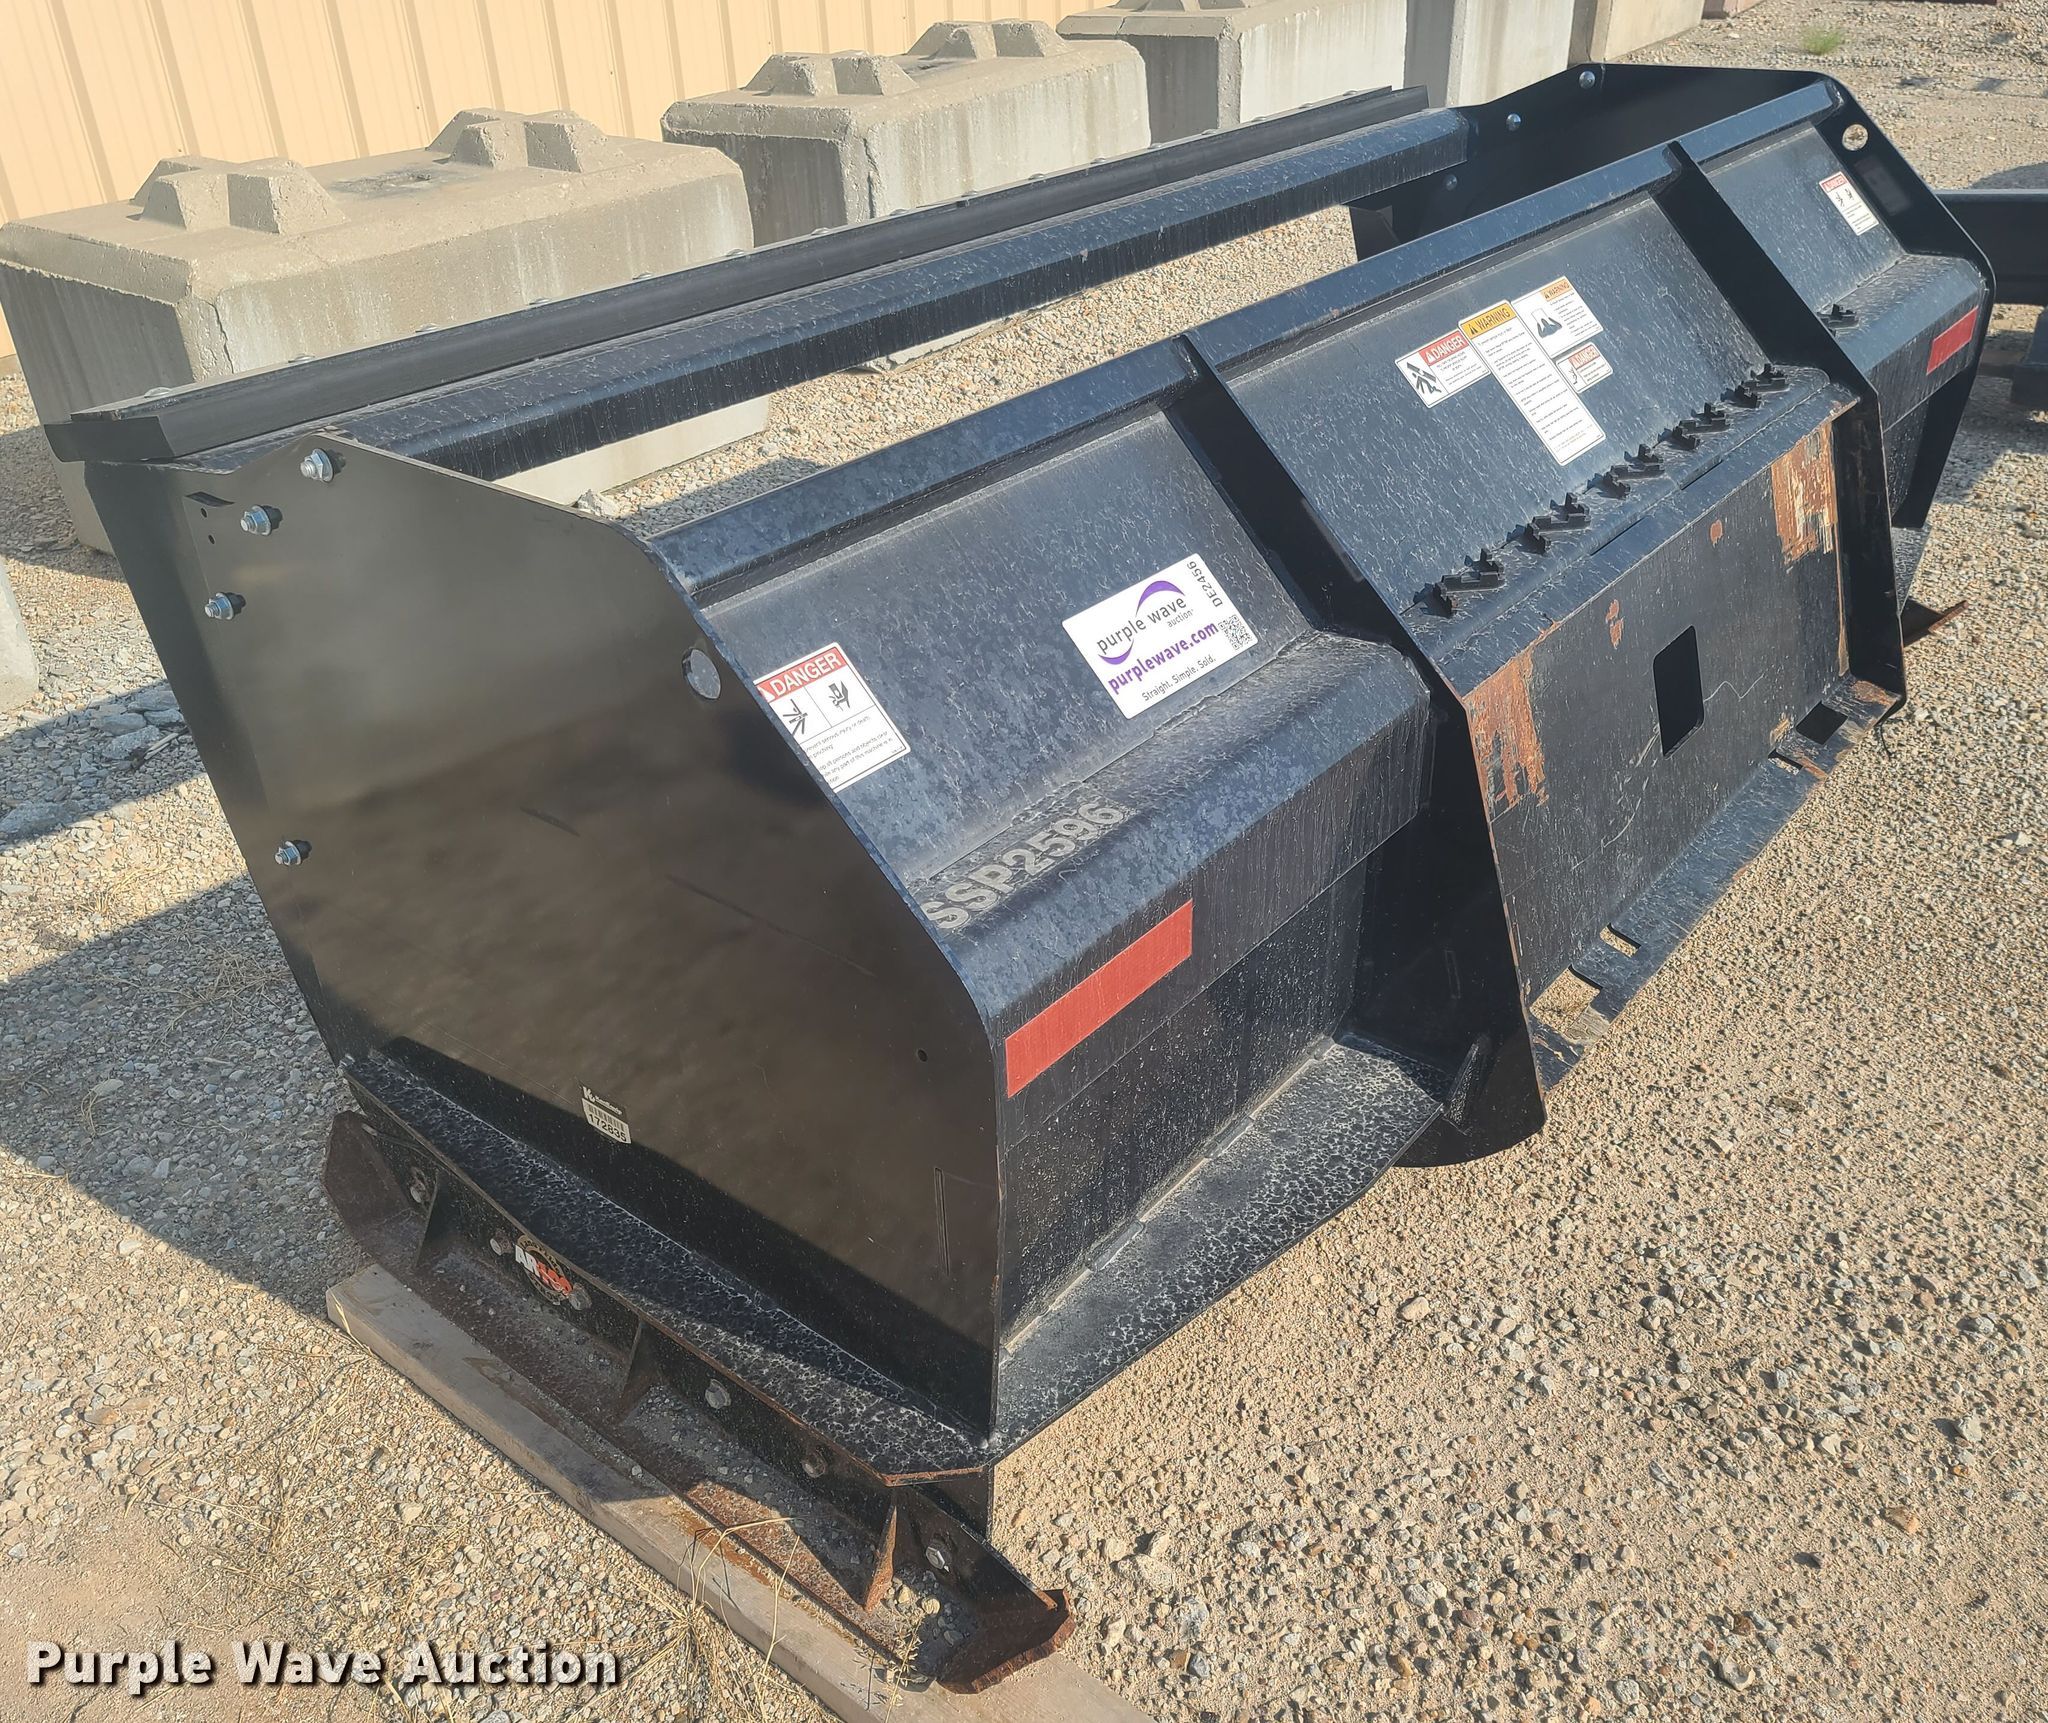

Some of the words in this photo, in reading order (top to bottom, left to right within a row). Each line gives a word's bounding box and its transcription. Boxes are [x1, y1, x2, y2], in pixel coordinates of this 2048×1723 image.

[1476, 308, 1511, 329] WARNING
[1432, 335, 1465, 360] DANGER
[1187, 561, 1223, 608] DE2456
[1097, 619, 1147, 656] purple
[1148, 597, 1187, 624] wave
[1167, 610, 1194, 628] auction
[770, 653, 841, 696] DANGER
[1108, 622, 1219, 694] purplewave.com
[1142, 680, 1174, 701] Straight.
[1172, 666, 1199, 684] Simple.
[1198, 654, 1217, 669] Sold.
[921, 803, 1124, 929] SSP2596
[589, 1114, 626, 1141] 172835
